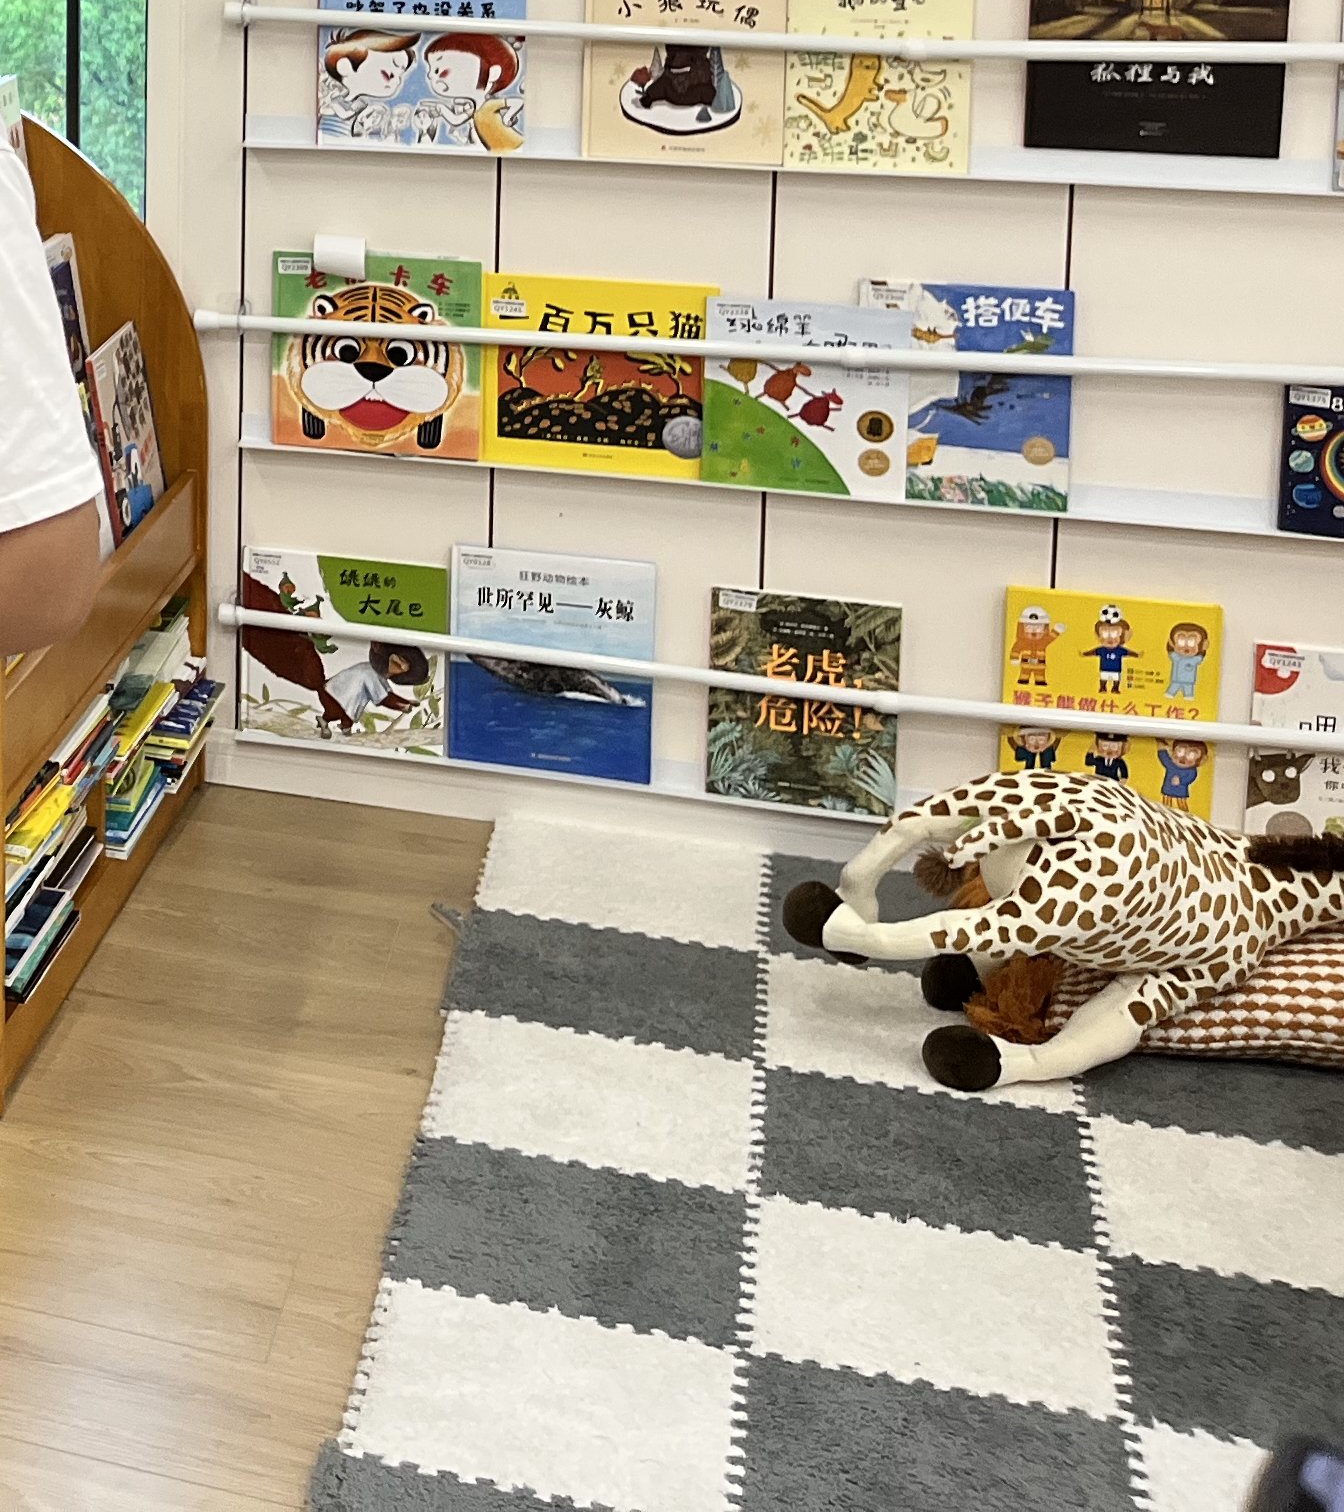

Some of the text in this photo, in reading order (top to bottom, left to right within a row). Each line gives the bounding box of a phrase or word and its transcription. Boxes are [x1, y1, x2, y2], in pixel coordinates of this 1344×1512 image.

[1090, 61, 1215, 85] 狐狸与我
[304, 264, 453, 296] 老卡车
[498, 302, 704, 340] 一百万只猫
[961, 295, 1065, 334] 搭便车
